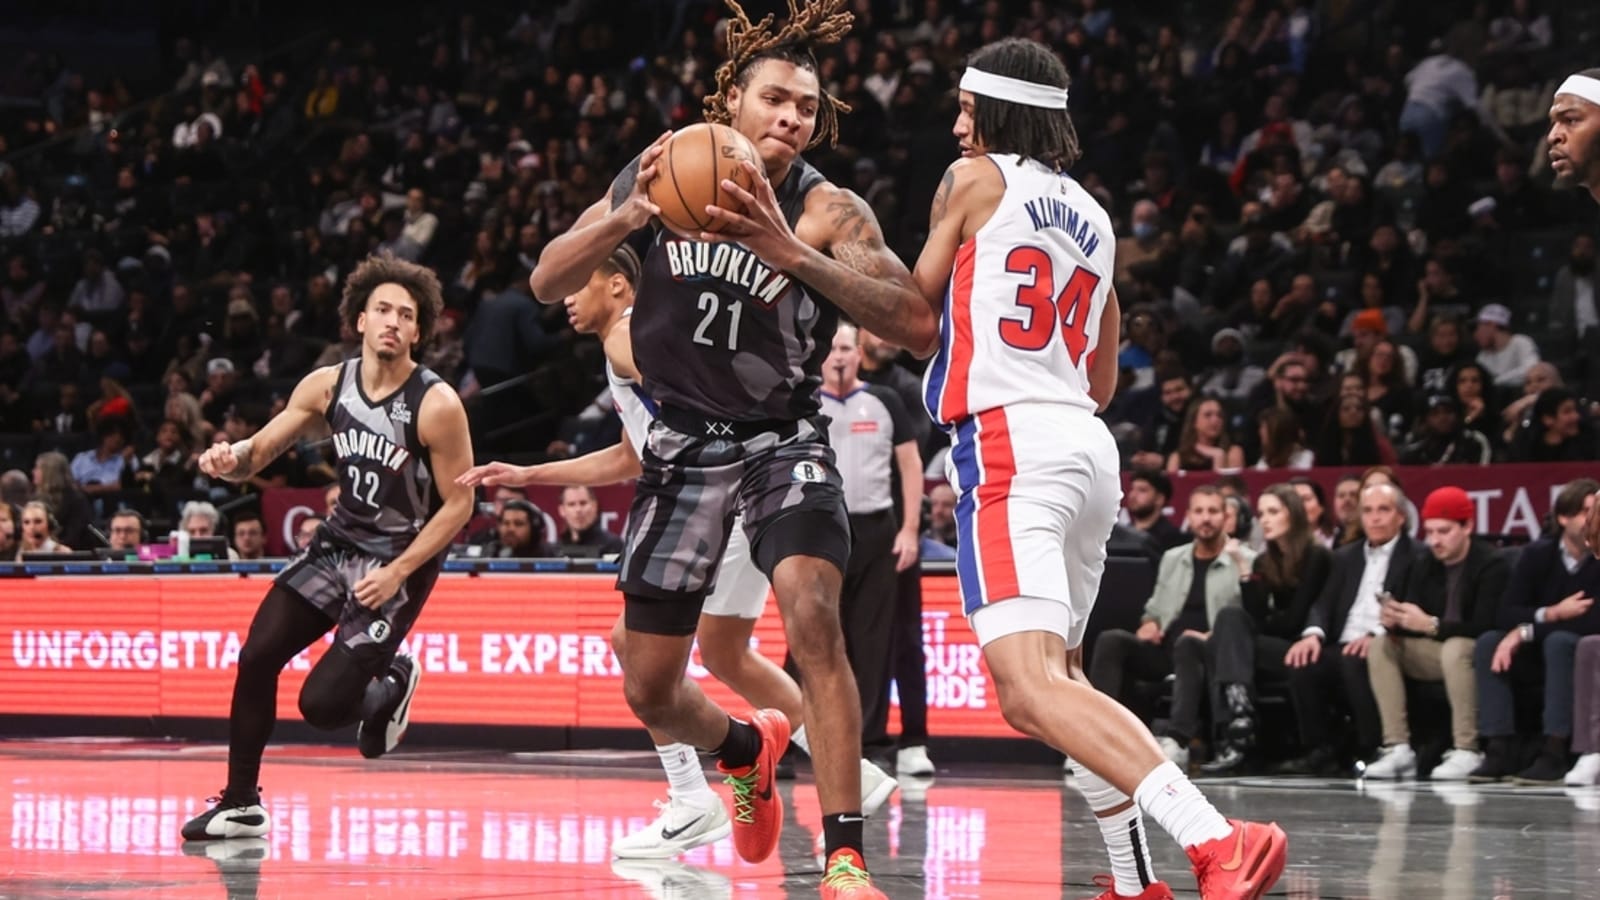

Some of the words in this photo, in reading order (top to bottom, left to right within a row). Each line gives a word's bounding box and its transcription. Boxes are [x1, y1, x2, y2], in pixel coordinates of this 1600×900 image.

[1024, 196, 1100, 258] KLINTMAN
[665, 240, 790, 304] BROOKLYN
[693, 291, 743, 351] 21
[998, 245, 1101, 370] 34
[333, 427, 410, 472] BROOKLYN
[347, 465, 380, 509] 22
[12, 630, 311, 670] UNFORGETTAE
